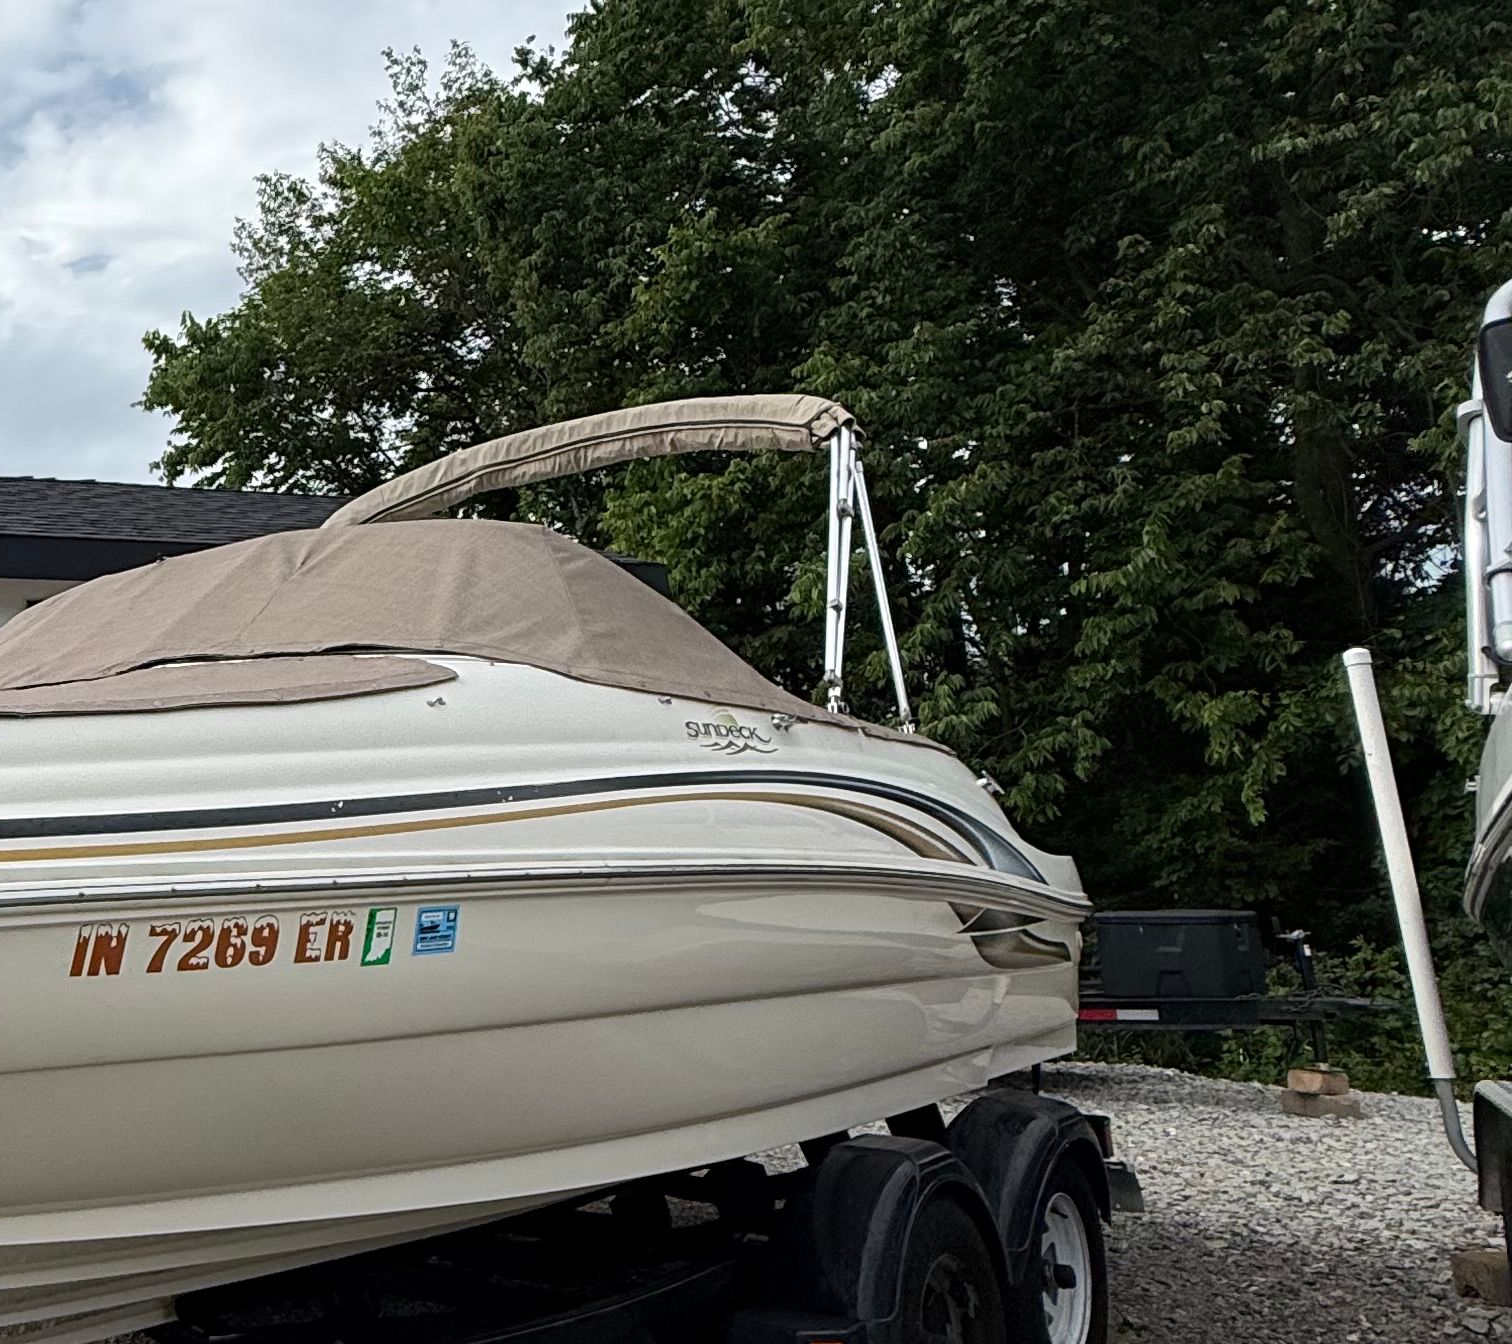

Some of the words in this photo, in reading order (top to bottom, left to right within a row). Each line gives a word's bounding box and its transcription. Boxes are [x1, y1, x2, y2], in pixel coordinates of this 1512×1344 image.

[69, 922, 130, 977] IN
[146, 913, 280, 973] 7269
[294, 910, 356, 964] ER
